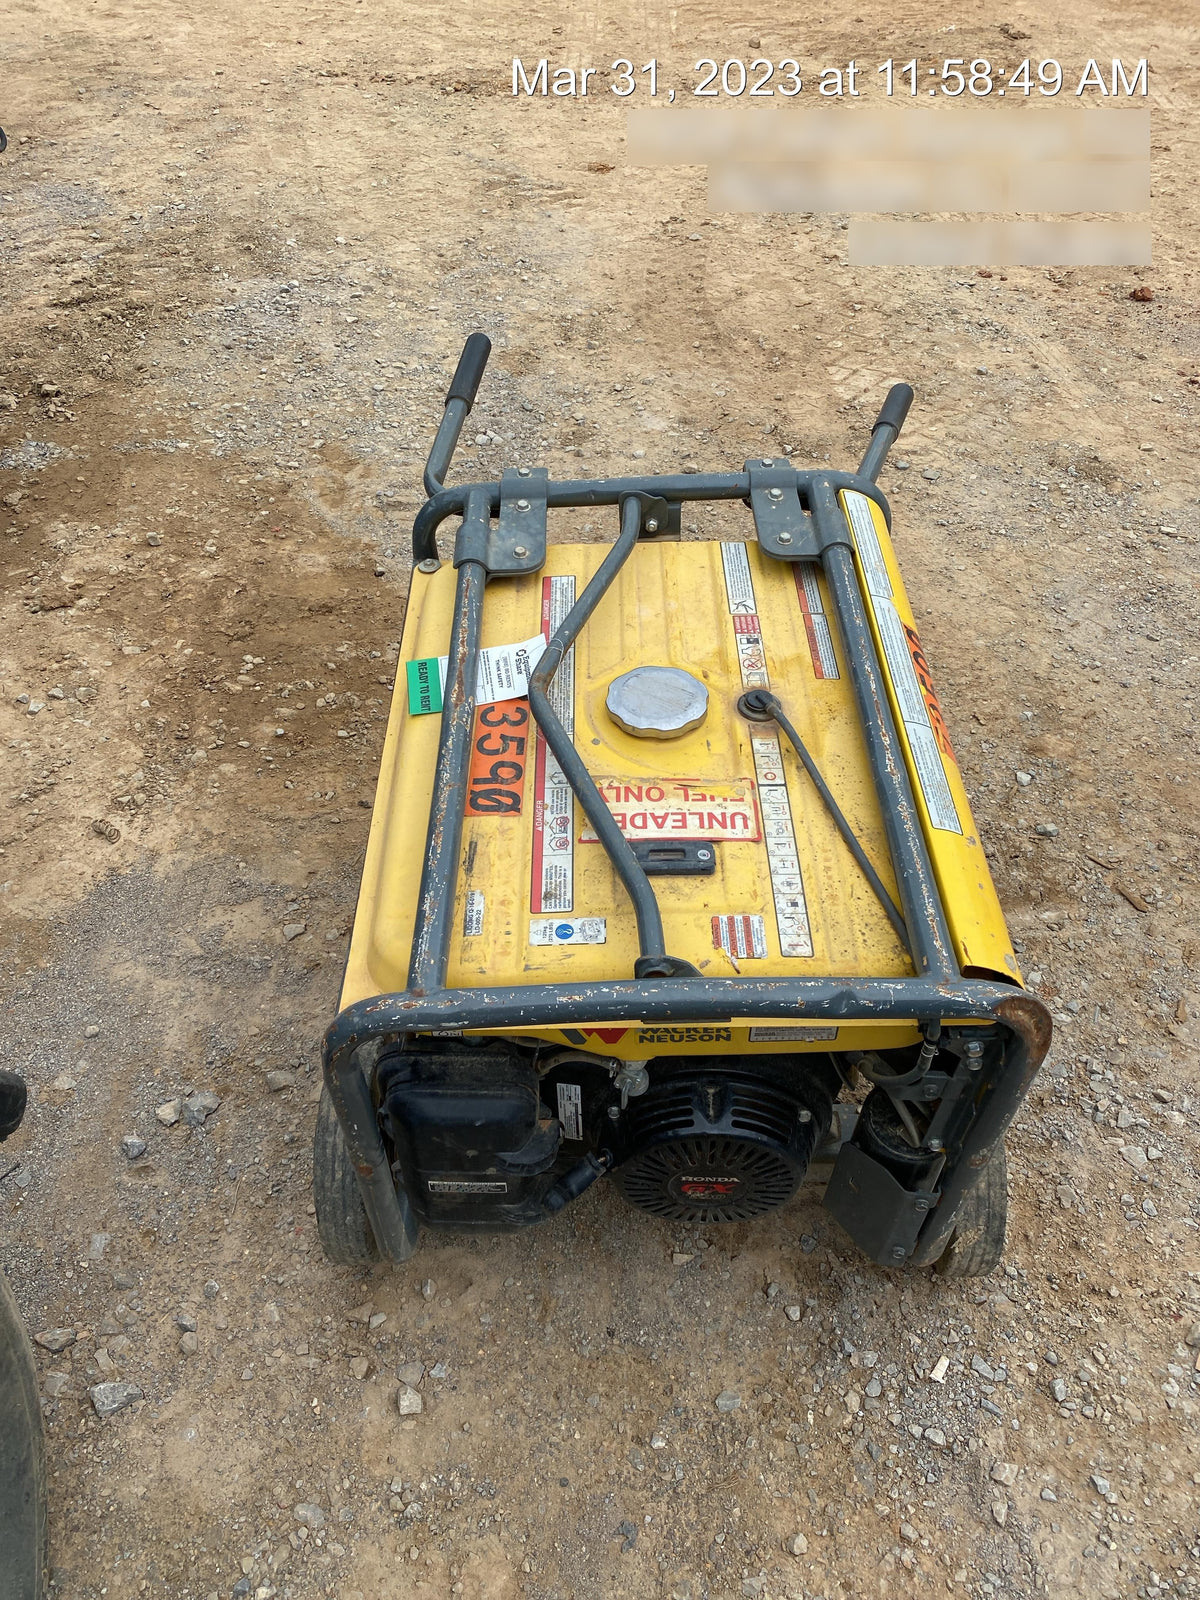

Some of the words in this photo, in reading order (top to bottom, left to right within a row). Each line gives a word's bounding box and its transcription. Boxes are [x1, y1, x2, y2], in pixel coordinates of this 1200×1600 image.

[417, 661, 429, 684] READY
[515, 657, 523, 675] Share
[522, 655, 531, 684] Equipme
[419, 685, 430, 694] TO
[420, 695, 431, 711] RENT
[535, 800, 544, 827] DANGER
[610, 811, 750, 830] UNLEADE
[639, 1034, 732, 1044] NEUSON
[681, 1183, 737, 1194] GX
